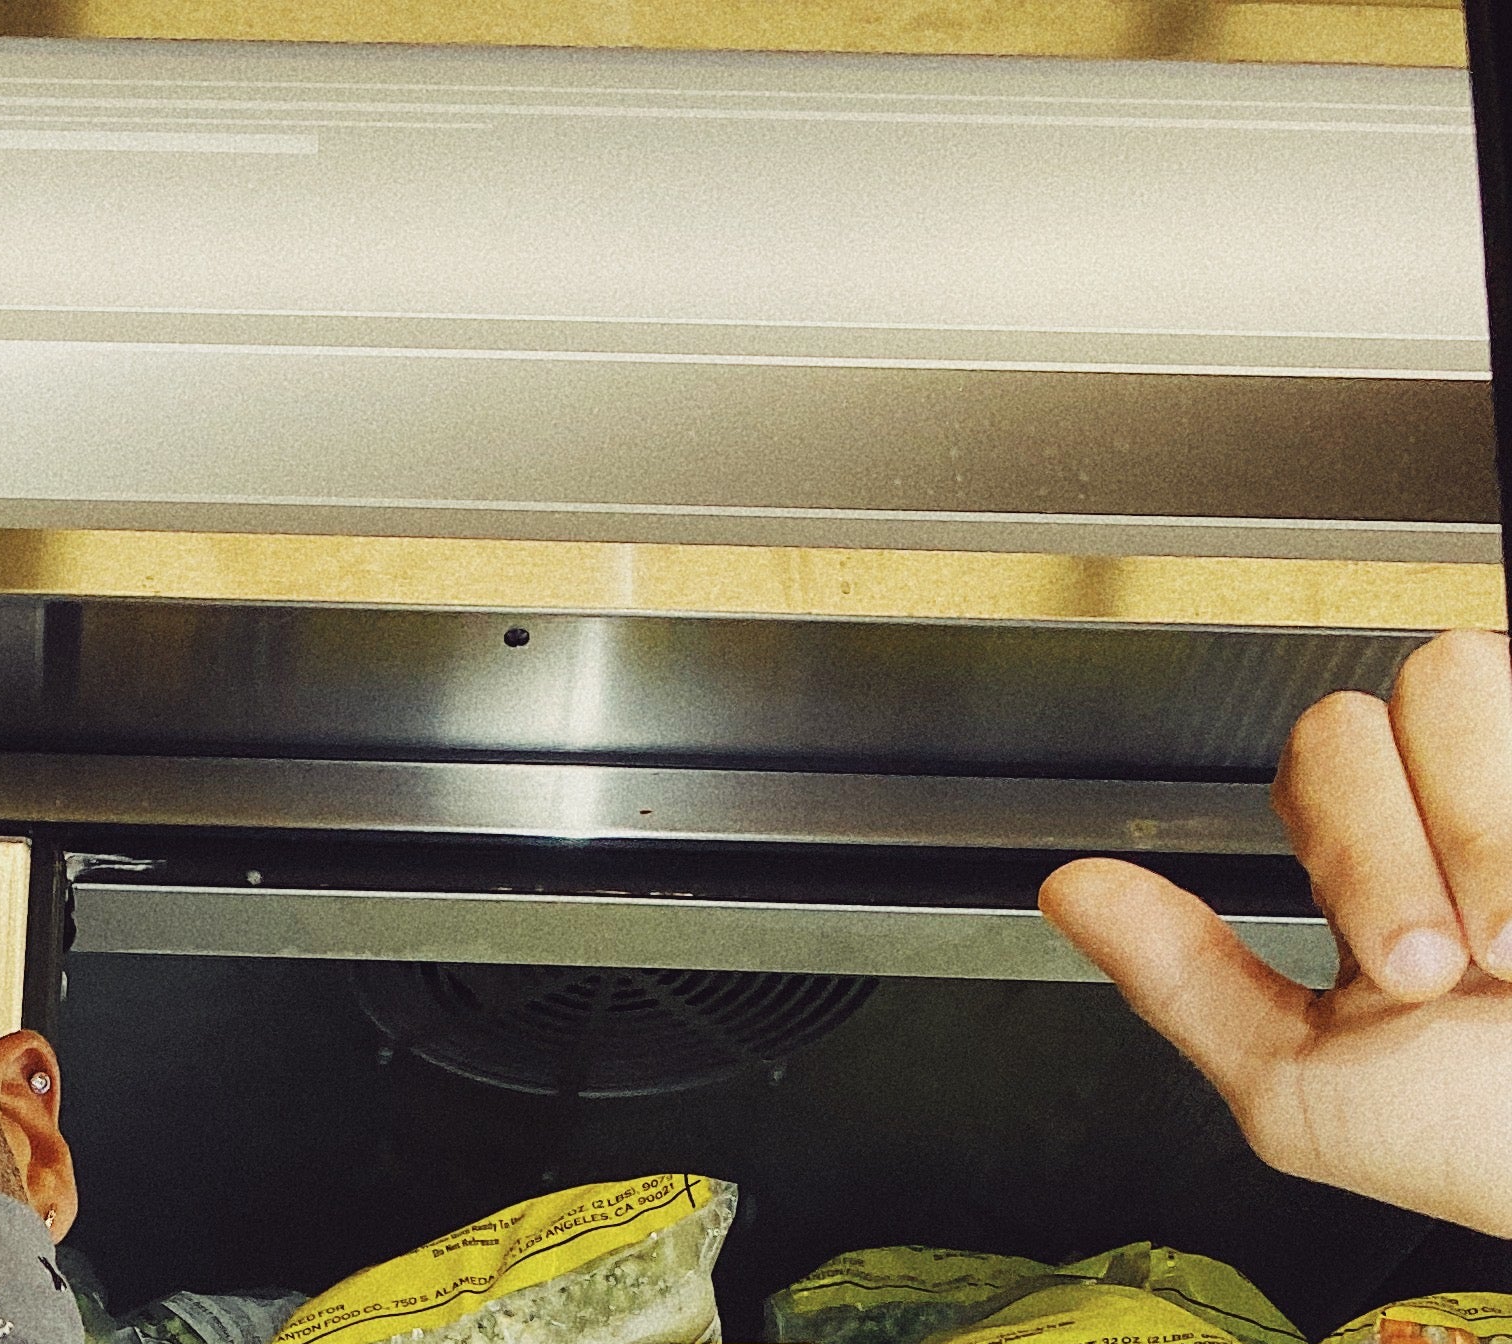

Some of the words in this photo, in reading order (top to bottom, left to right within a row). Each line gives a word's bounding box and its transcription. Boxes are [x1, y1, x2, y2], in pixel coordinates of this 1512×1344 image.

[276, 1322, 323, 1342] ANTON
[324, 1309, 362, 1328] FOOD
[392, 1296, 417, 1309] 750
[434, 1275, 496, 1299] ALAMEDA
[614, 1202, 635, 1218] CA
[637, 1182, 675, 1206] 90021
[318, 1304, 345, 1319] FOR
[1121, 1335, 1141, 1344] OZ
